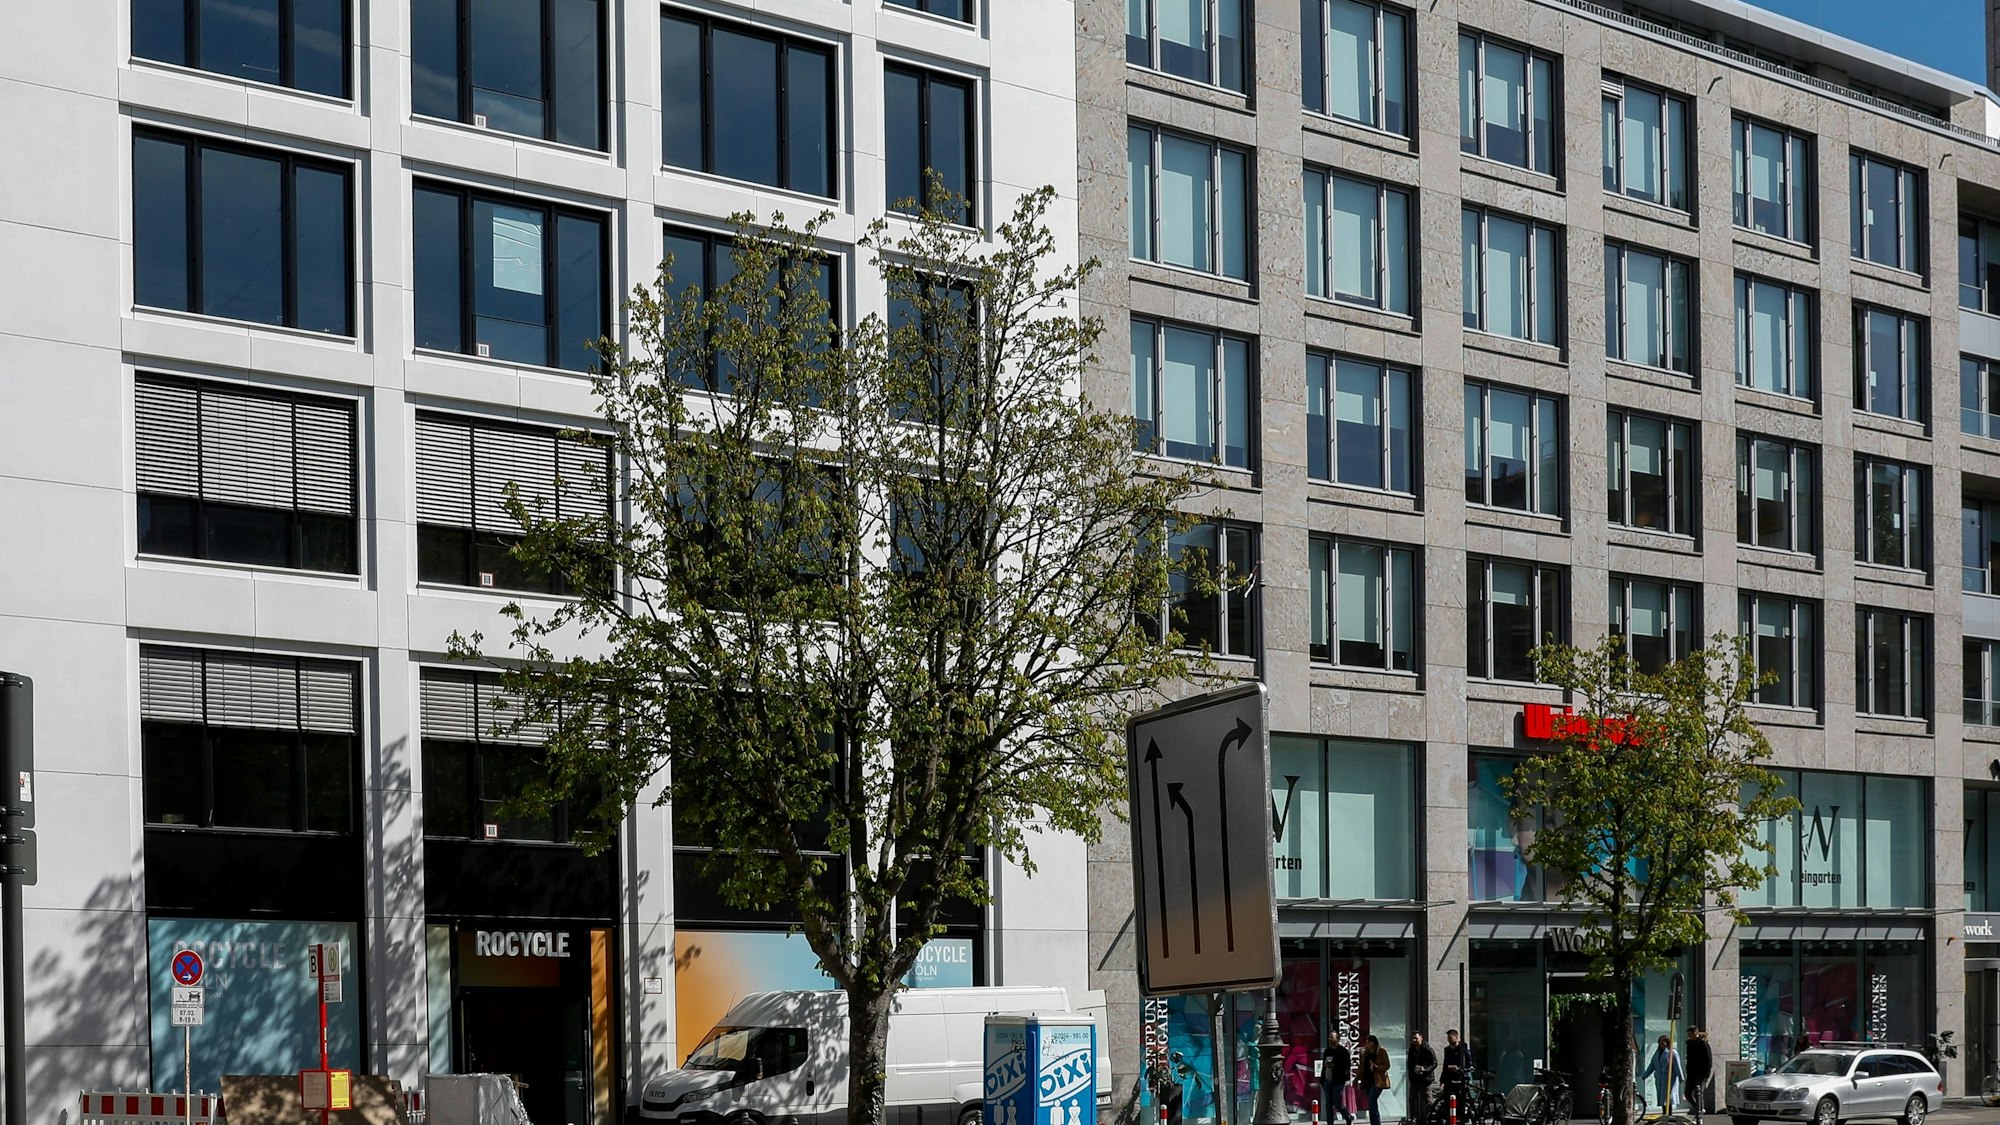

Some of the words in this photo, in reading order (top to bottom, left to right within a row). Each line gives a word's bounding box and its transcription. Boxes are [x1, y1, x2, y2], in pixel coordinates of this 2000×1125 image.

[1791, 870, 1842, 887] eingarten
[1963, 920, 1993, 936] work
[476, 930, 571, 958] ROCYCLE
[916, 945, 967, 963] OCYCLE
[311, 955, 317, 973] B
[1741, 976, 1750, 1061] REFFPUNKT
[1749, 975, 1758, 1075] WEINGARTEN
[649, 1090, 666, 1098] IVECO
